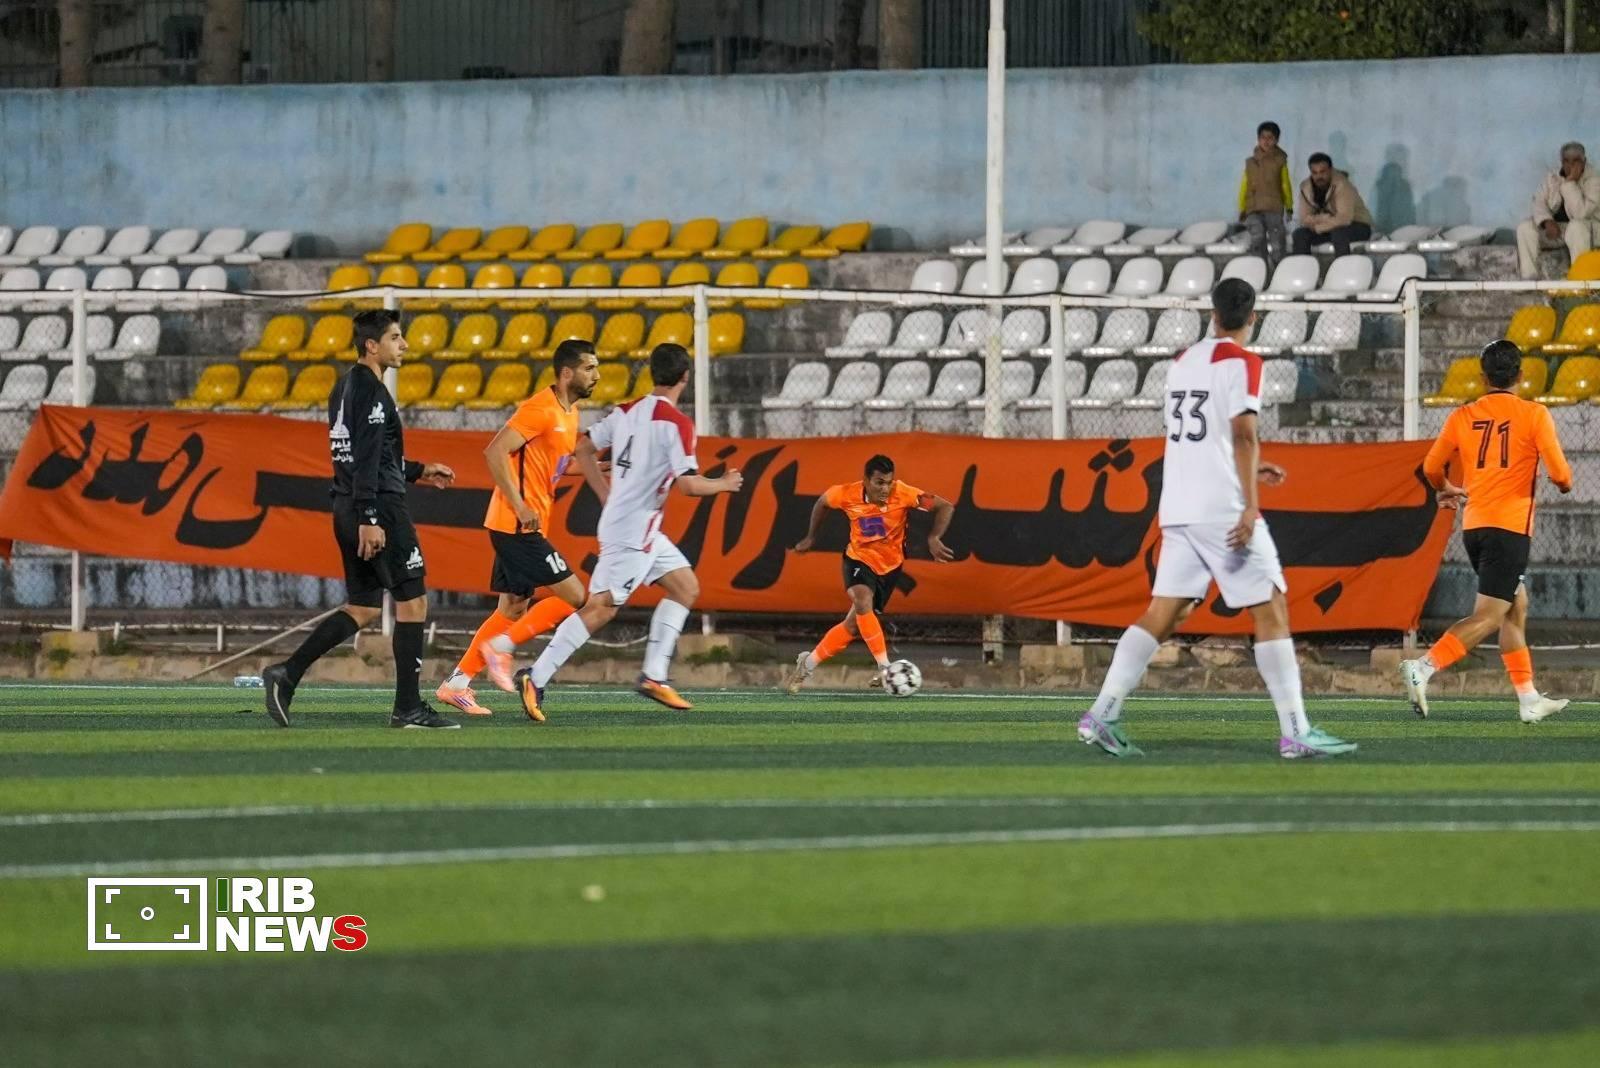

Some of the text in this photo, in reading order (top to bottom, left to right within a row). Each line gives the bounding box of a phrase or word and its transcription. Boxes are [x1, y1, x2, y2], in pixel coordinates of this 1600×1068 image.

[1170, 390, 1209, 442] 33
[617, 434, 634, 479] 4
[1472, 419, 1511, 469] 71
[545, 551, 568, 575] 16
[623, 578, 635, 591] 4
